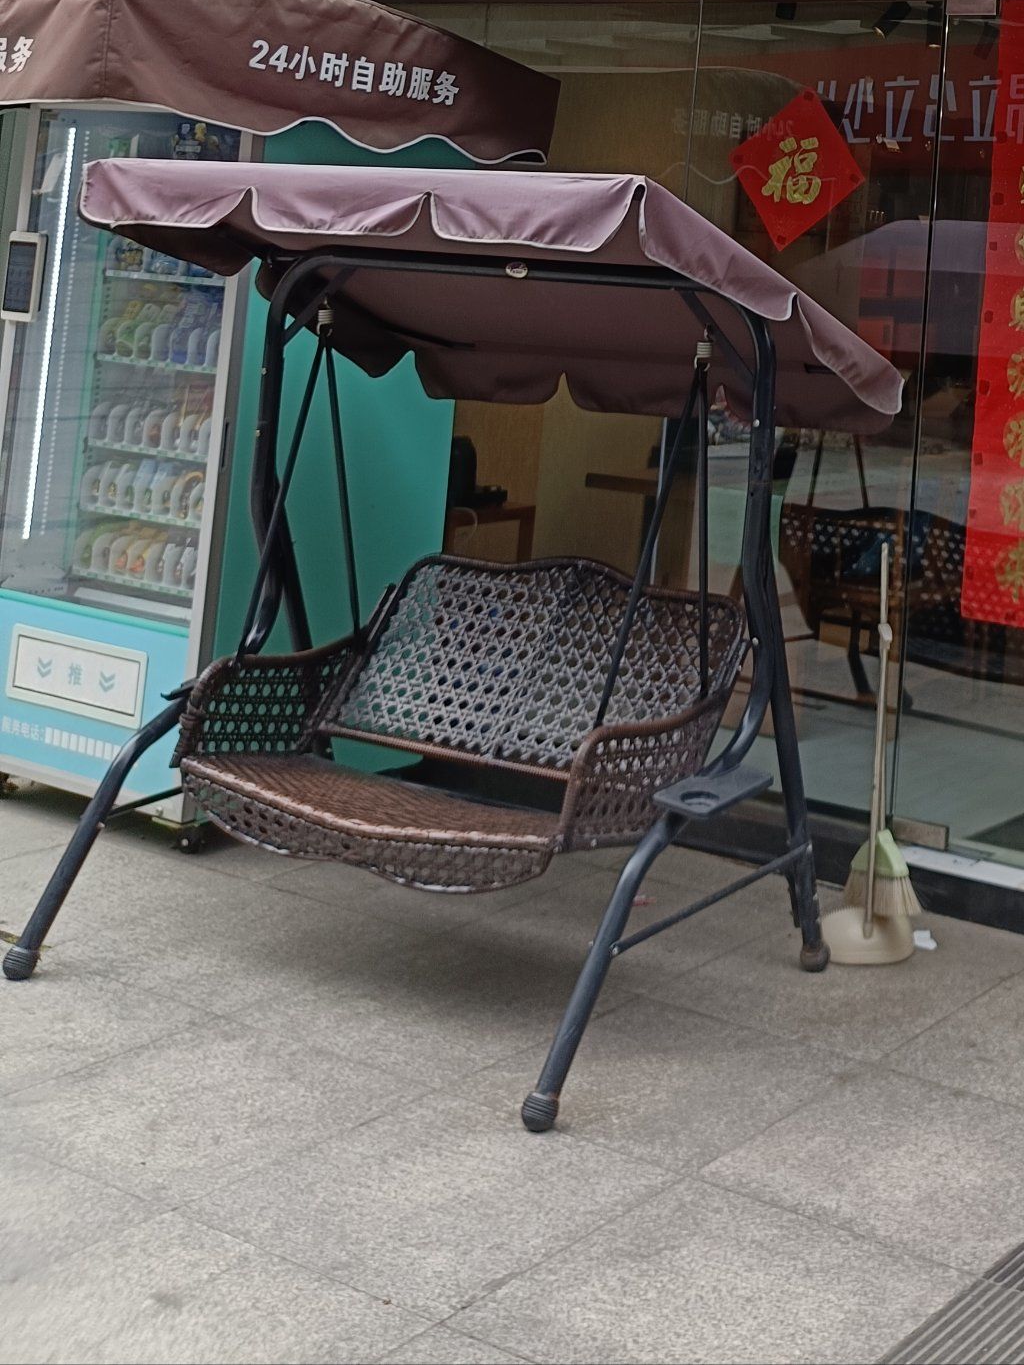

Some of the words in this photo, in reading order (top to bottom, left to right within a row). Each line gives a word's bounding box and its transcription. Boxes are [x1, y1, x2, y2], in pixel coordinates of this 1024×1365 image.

[248, 38, 460, 107] 24小时自助服务
[761, 135, 823, 206] 福
[68, 662, 84, 686] 推
